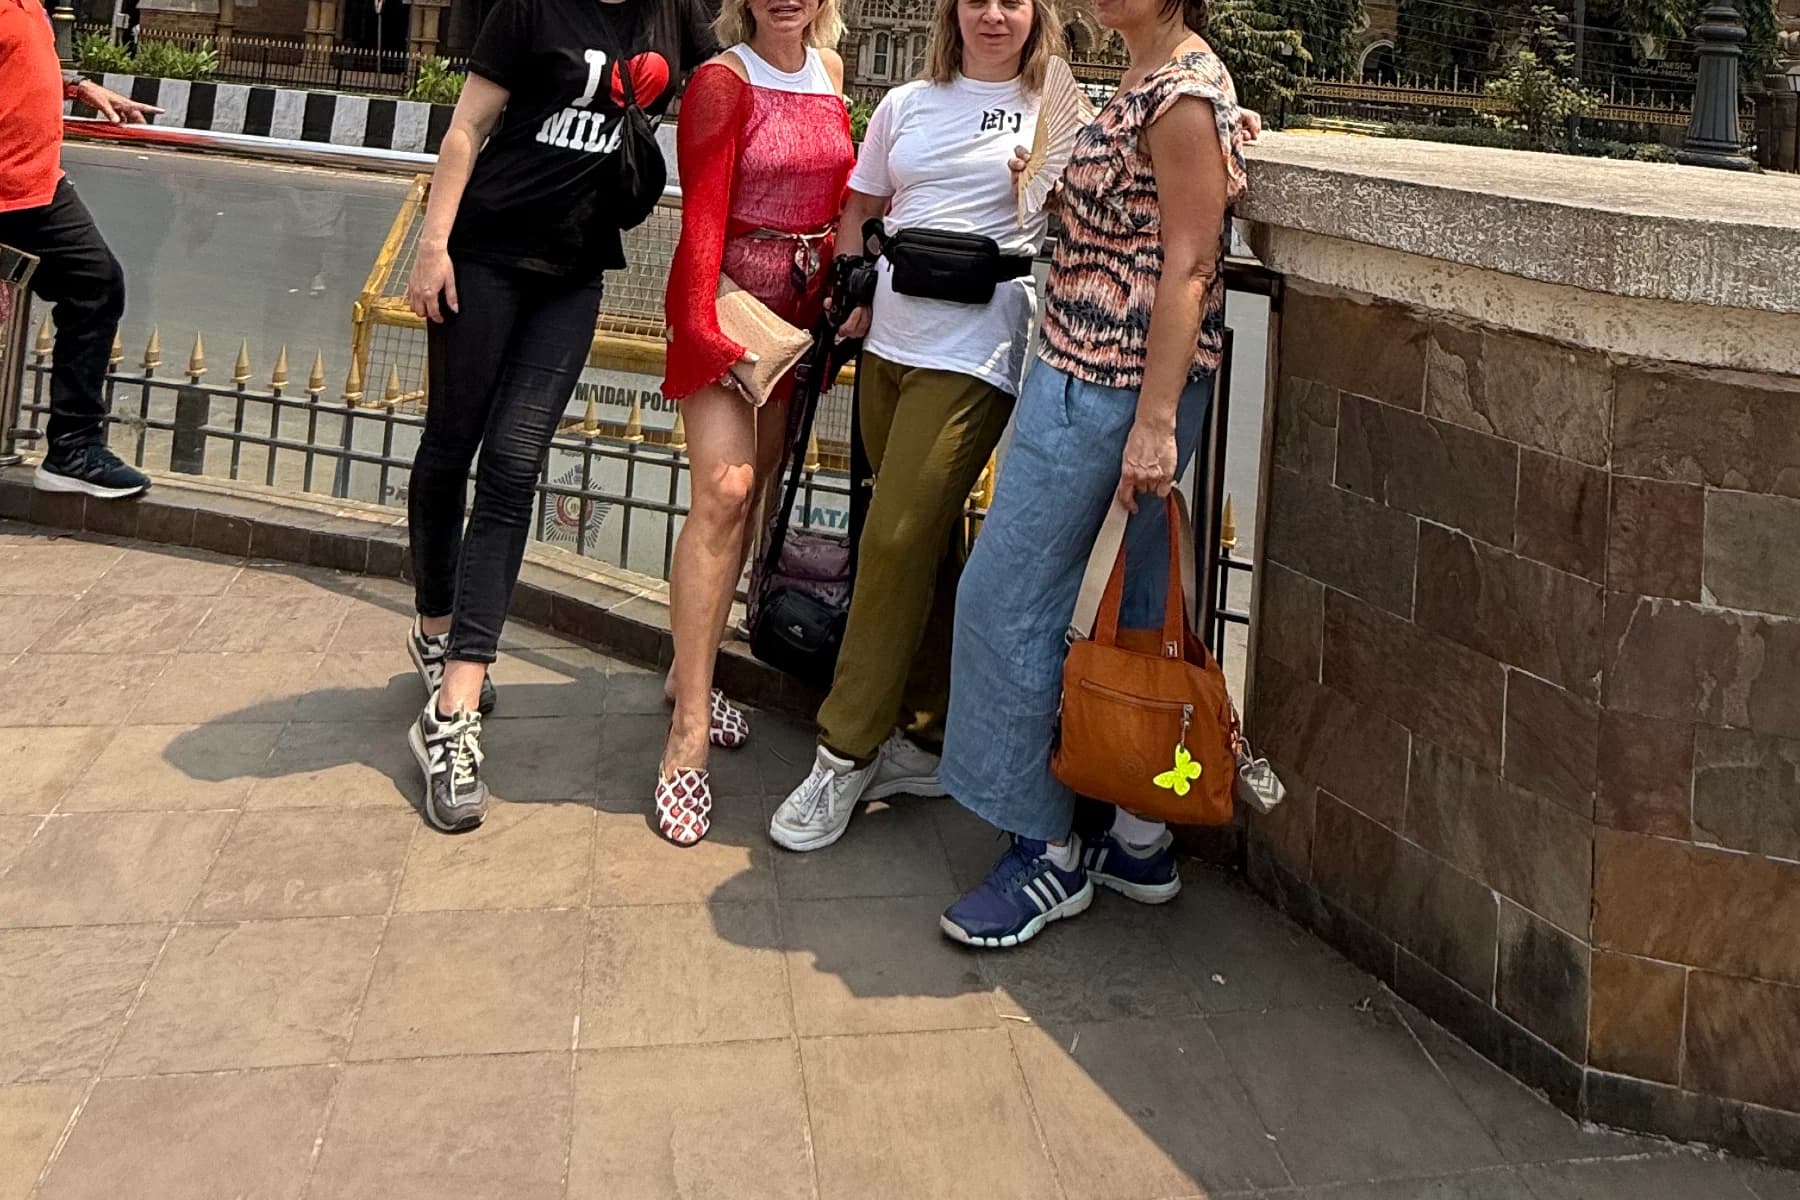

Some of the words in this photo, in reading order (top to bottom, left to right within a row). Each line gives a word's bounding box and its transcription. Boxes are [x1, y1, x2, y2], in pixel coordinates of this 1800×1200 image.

[571, 49, 607, 107] I
[574, 382, 637, 408] MAIDAN
[640, 390, 679, 414] POLI
